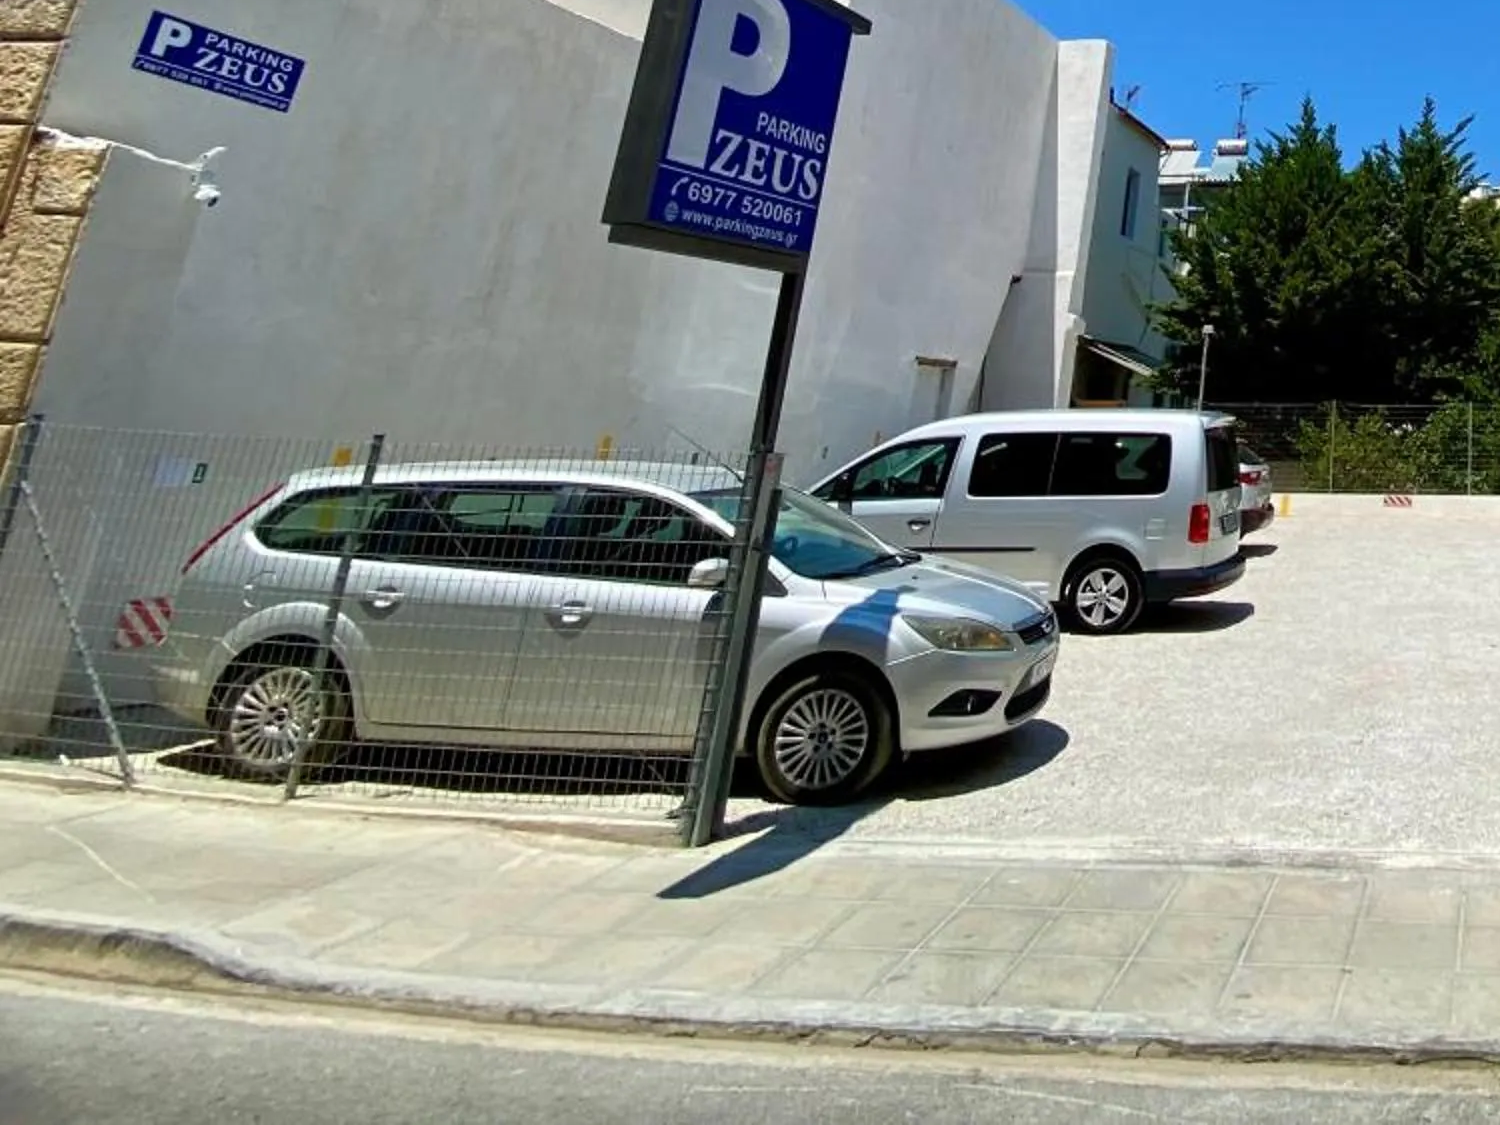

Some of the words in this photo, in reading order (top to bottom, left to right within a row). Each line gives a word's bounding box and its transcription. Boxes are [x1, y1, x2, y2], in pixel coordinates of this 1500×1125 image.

[150, 18, 193, 57] P
[205, 32, 294, 72] PARKING
[192, 47, 288, 94] ZEUS
[756, 111, 826, 153] PARKING
[710, 129, 822, 201] ZEUS
[687, 181, 738, 211] 6977
[740, 195, 803, 227] 520061
[681, 208, 799, 249] www.parkingzeus.gr
